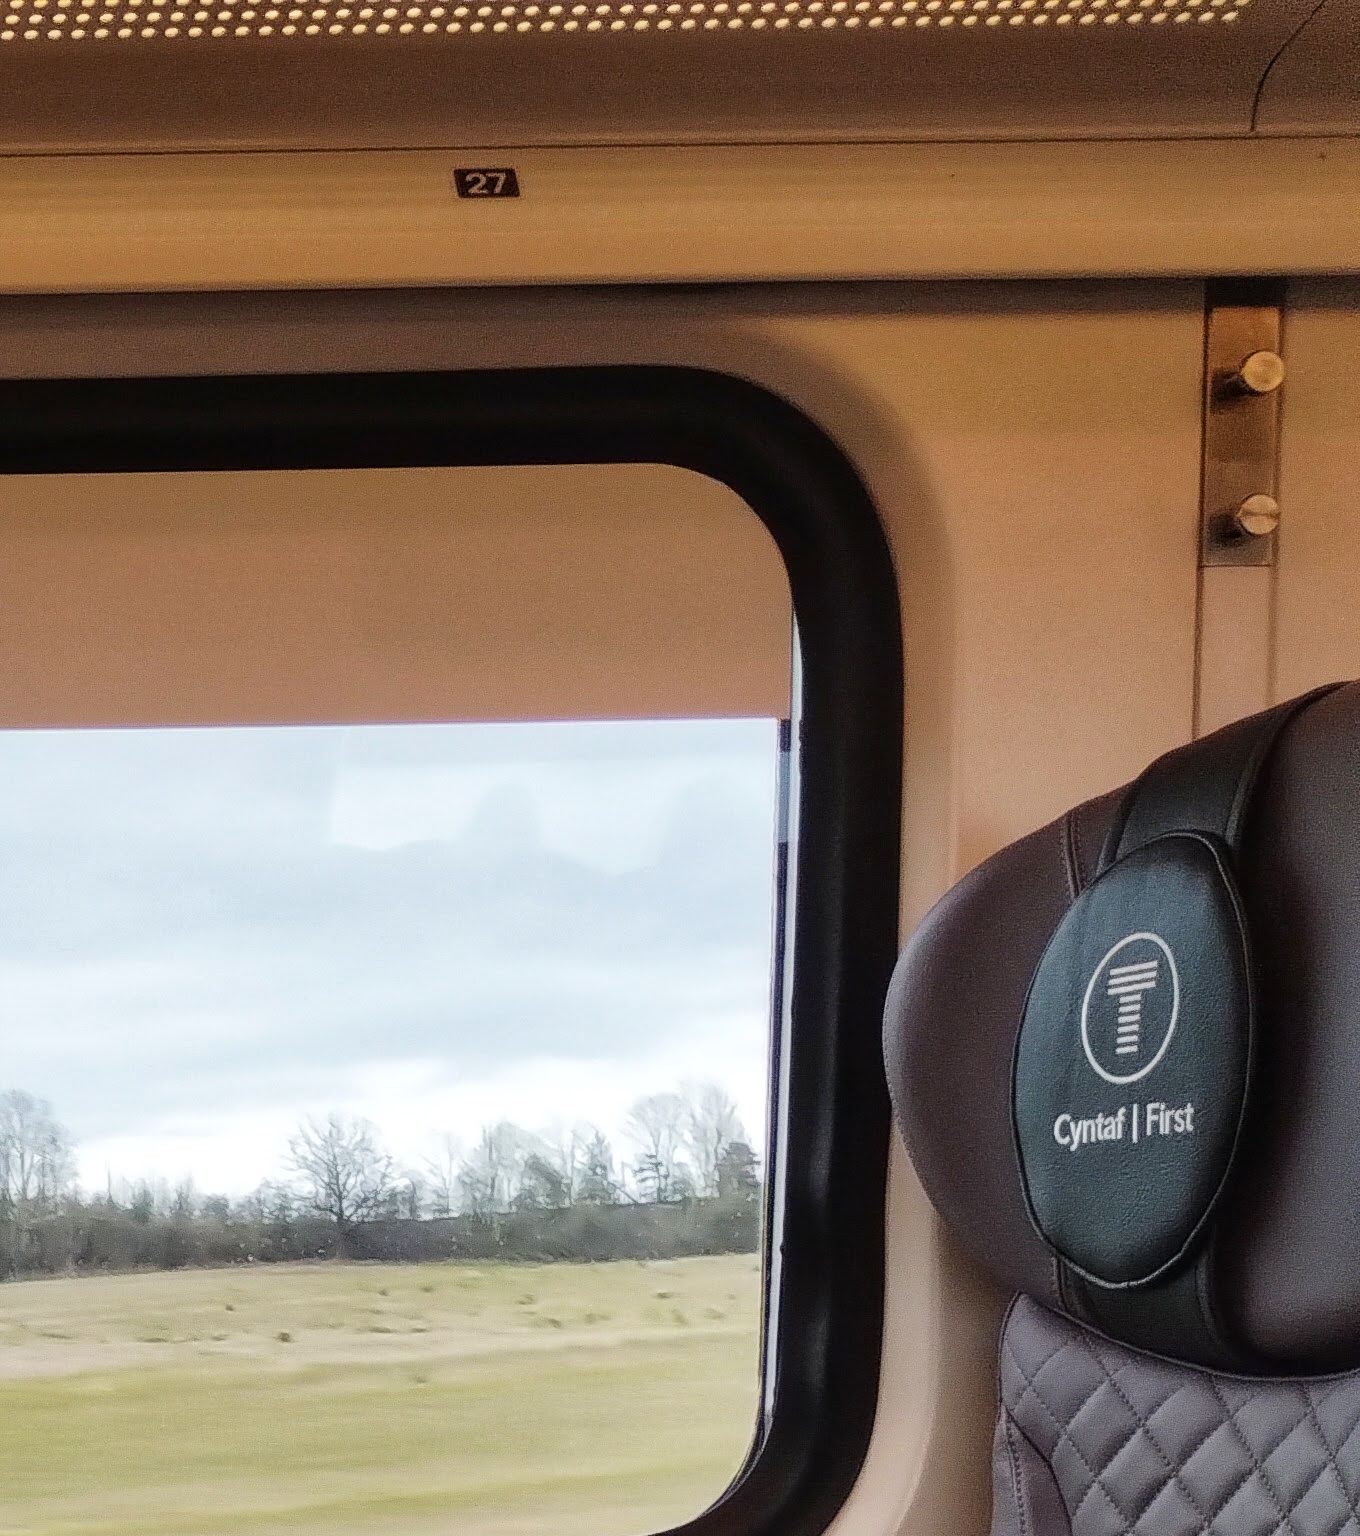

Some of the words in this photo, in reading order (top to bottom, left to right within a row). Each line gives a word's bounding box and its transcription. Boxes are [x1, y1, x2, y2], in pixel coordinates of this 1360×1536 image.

[465, 173, 508, 194] 27
[1053, 1106, 1125, 1153] Cyntaf
[1146, 1102, 1195, 1137] First
